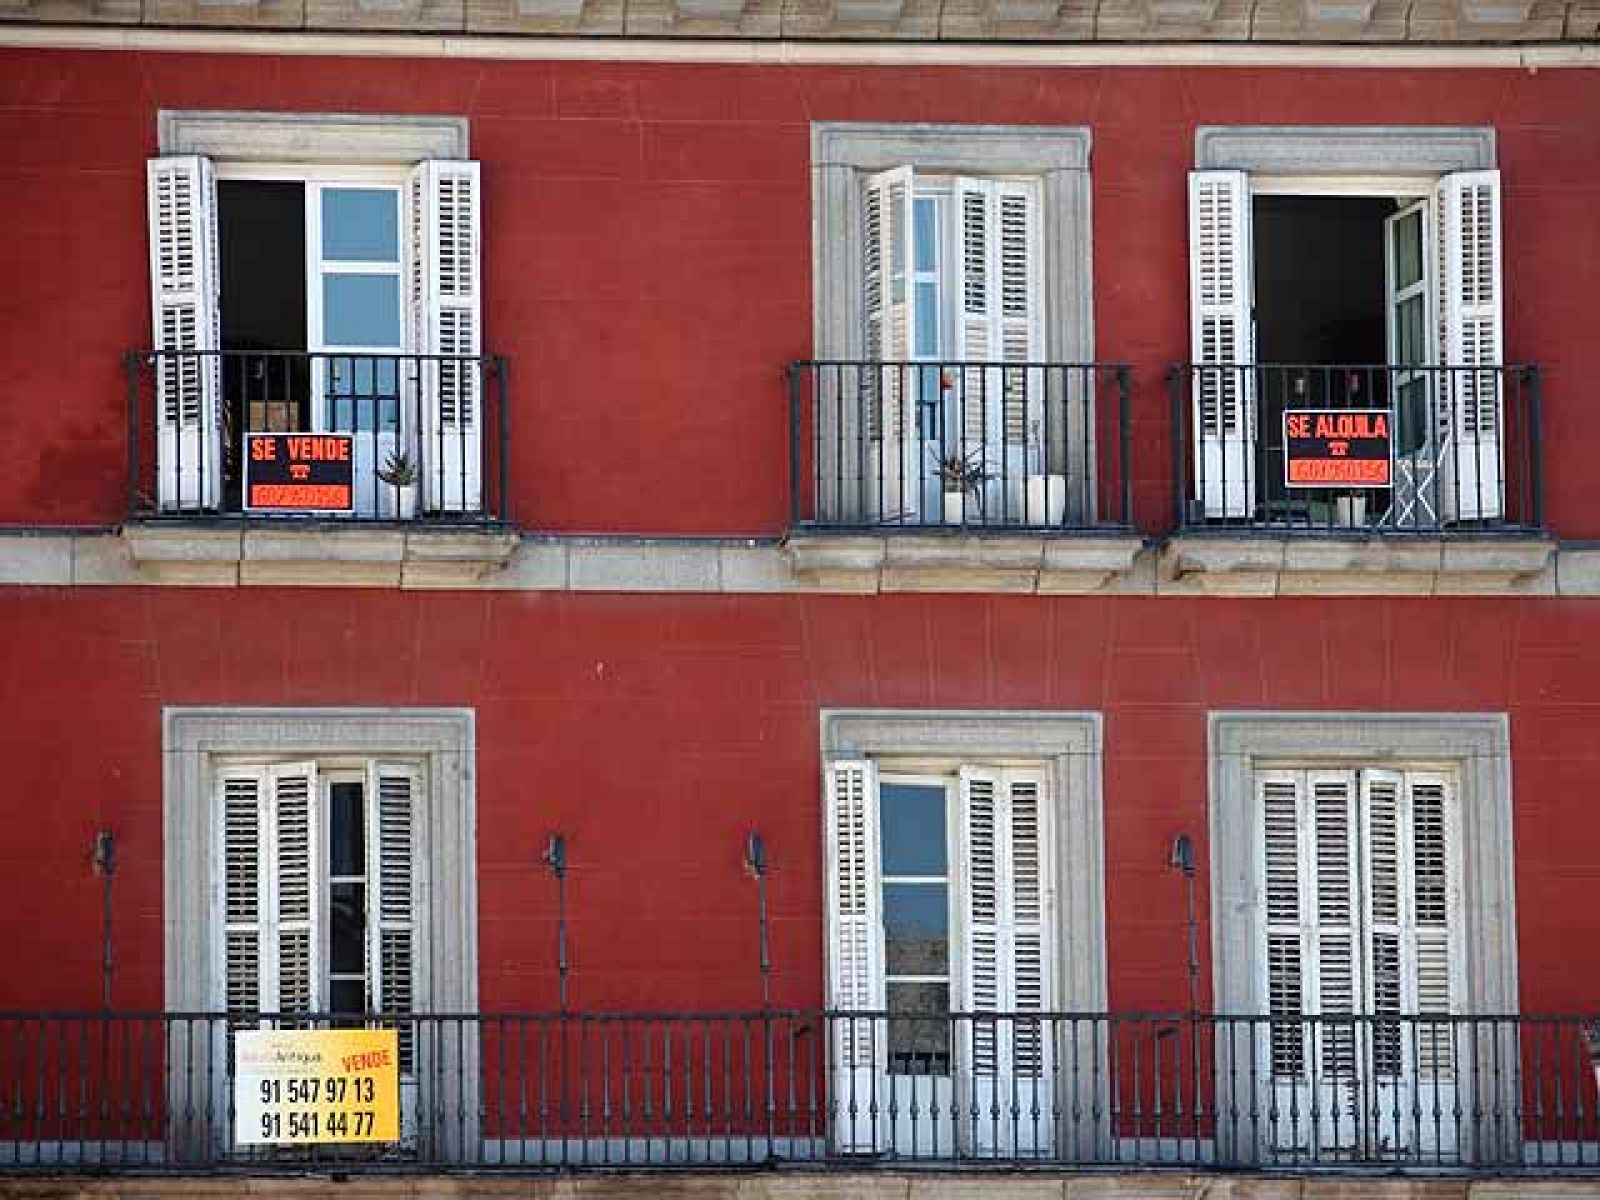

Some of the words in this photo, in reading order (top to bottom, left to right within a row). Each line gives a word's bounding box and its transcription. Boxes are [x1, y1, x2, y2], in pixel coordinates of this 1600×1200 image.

[1287, 414, 1311, 438] SE
[1315, 414, 1389, 438] ALQUILA
[251, 437, 276, 461] SE
[287, 437, 349, 461] VENDE
[342, 1049, 392, 1072] VENDE
[259, 1079, 281, 1103] 91
[287, 1079, 320, 1103] 547
[325, 1078, 346, 1103] 97
[353, 1077, 375, 1103] 13
[261, 1112, 281, 1137] 91
[289, 1112, 319, 1137] 541
[326, 1112, 348, 1137] 44
[354, 1112, 374, 1137] 77
